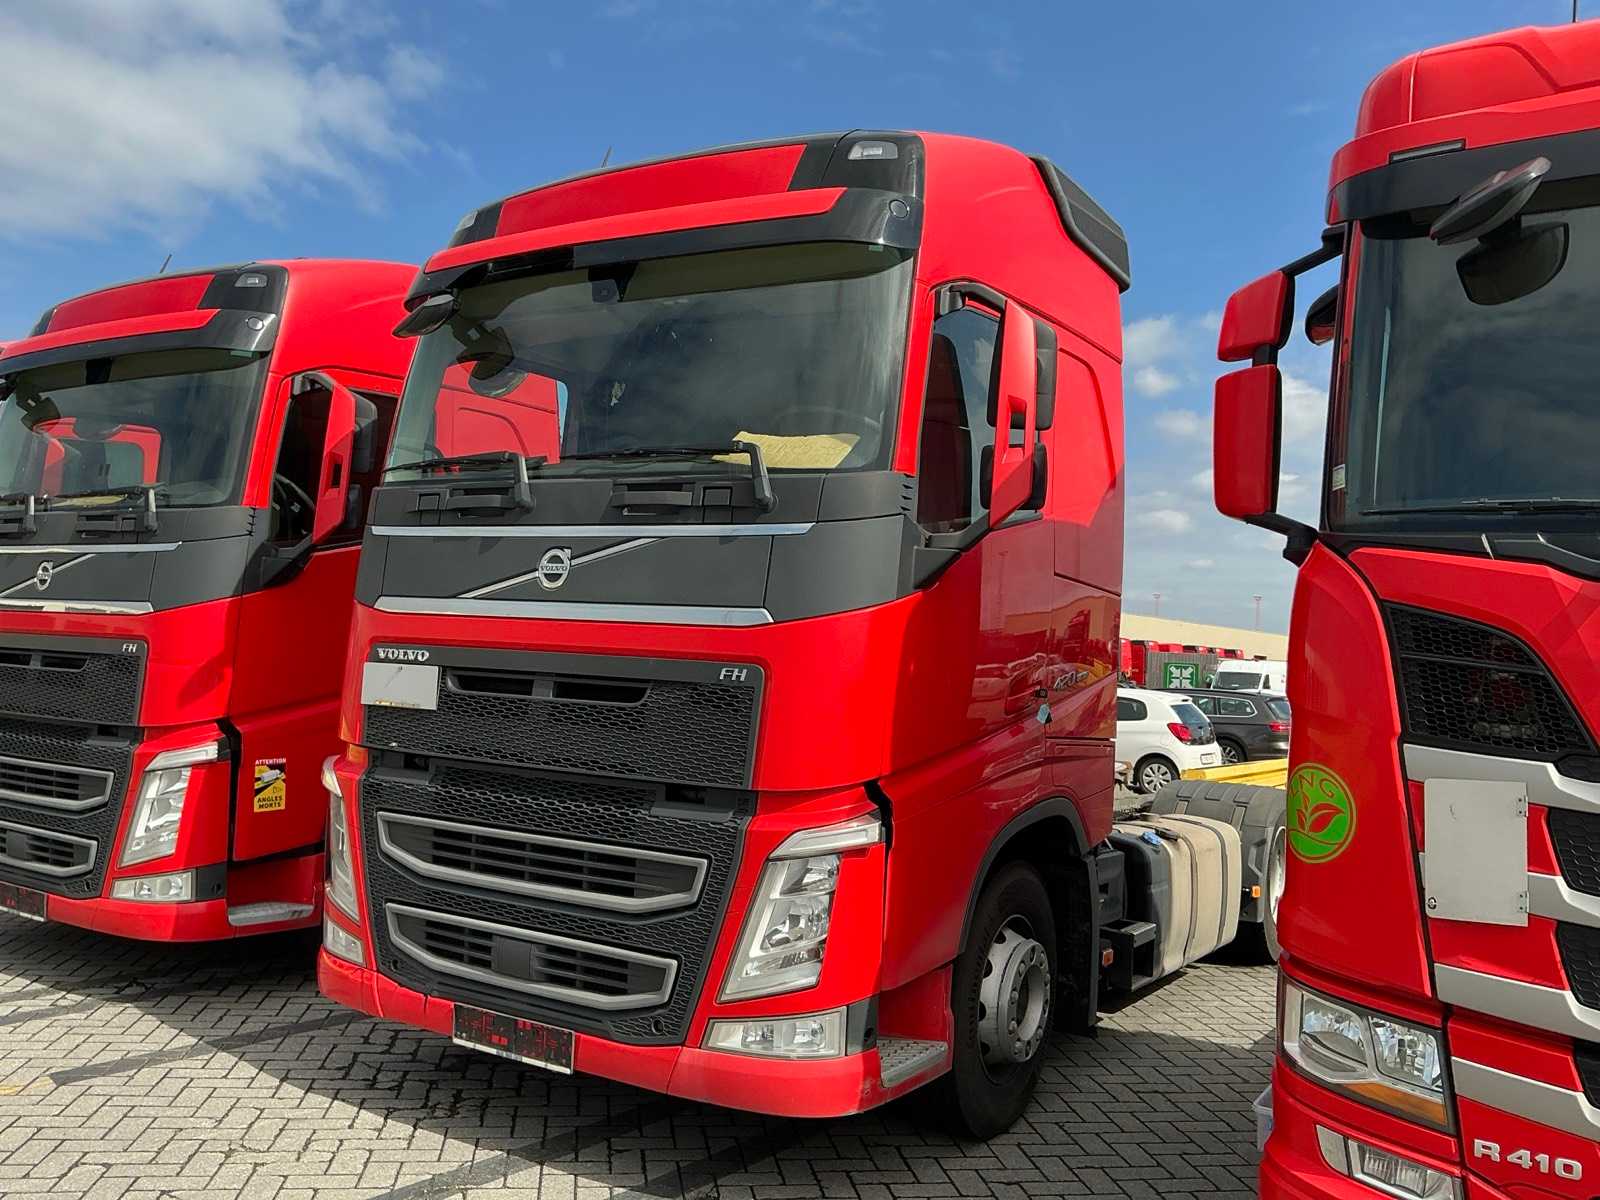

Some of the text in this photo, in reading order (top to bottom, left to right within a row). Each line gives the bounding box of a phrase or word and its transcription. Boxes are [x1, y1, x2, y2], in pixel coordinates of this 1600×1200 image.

[122, 643, 137, 653] FH
[376, 647, 430, 662] VOLVO
[719, 667, 748, 681] FH
[255, 757, 287, 765] ATTENTION
[257, 795, 283, 803] ANGLES
[1473, 1138, 1583, 1181] R 410
